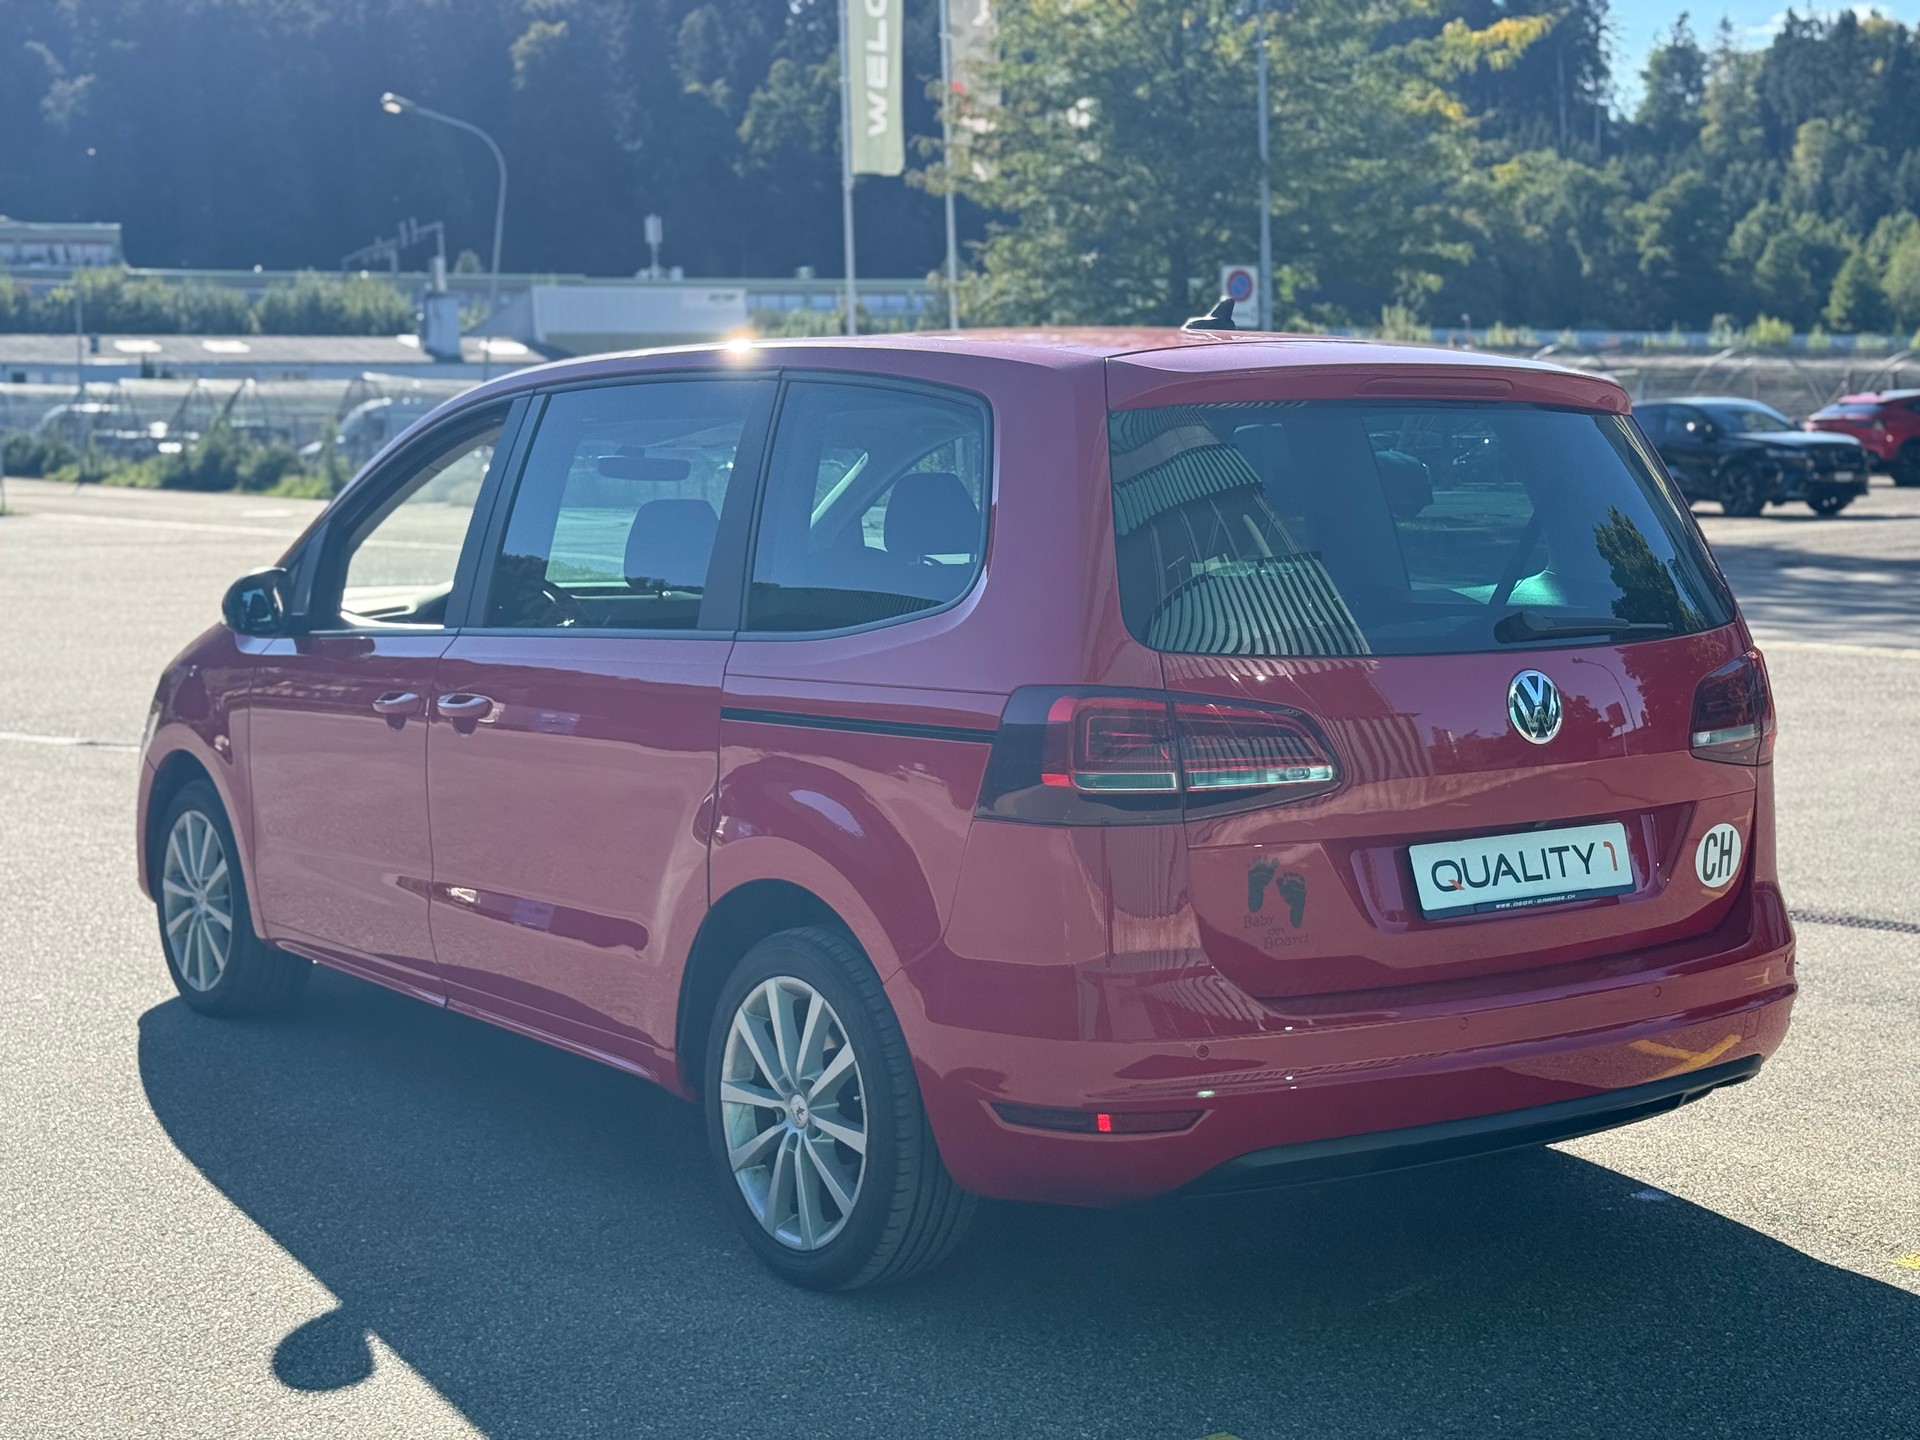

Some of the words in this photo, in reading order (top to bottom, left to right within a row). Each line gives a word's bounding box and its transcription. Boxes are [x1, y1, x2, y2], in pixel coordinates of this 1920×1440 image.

[1703, 830, 1733, 881] CH
[1244, 915, 1274, 929] Baby
[1264, 934, 1308, 949] Board
